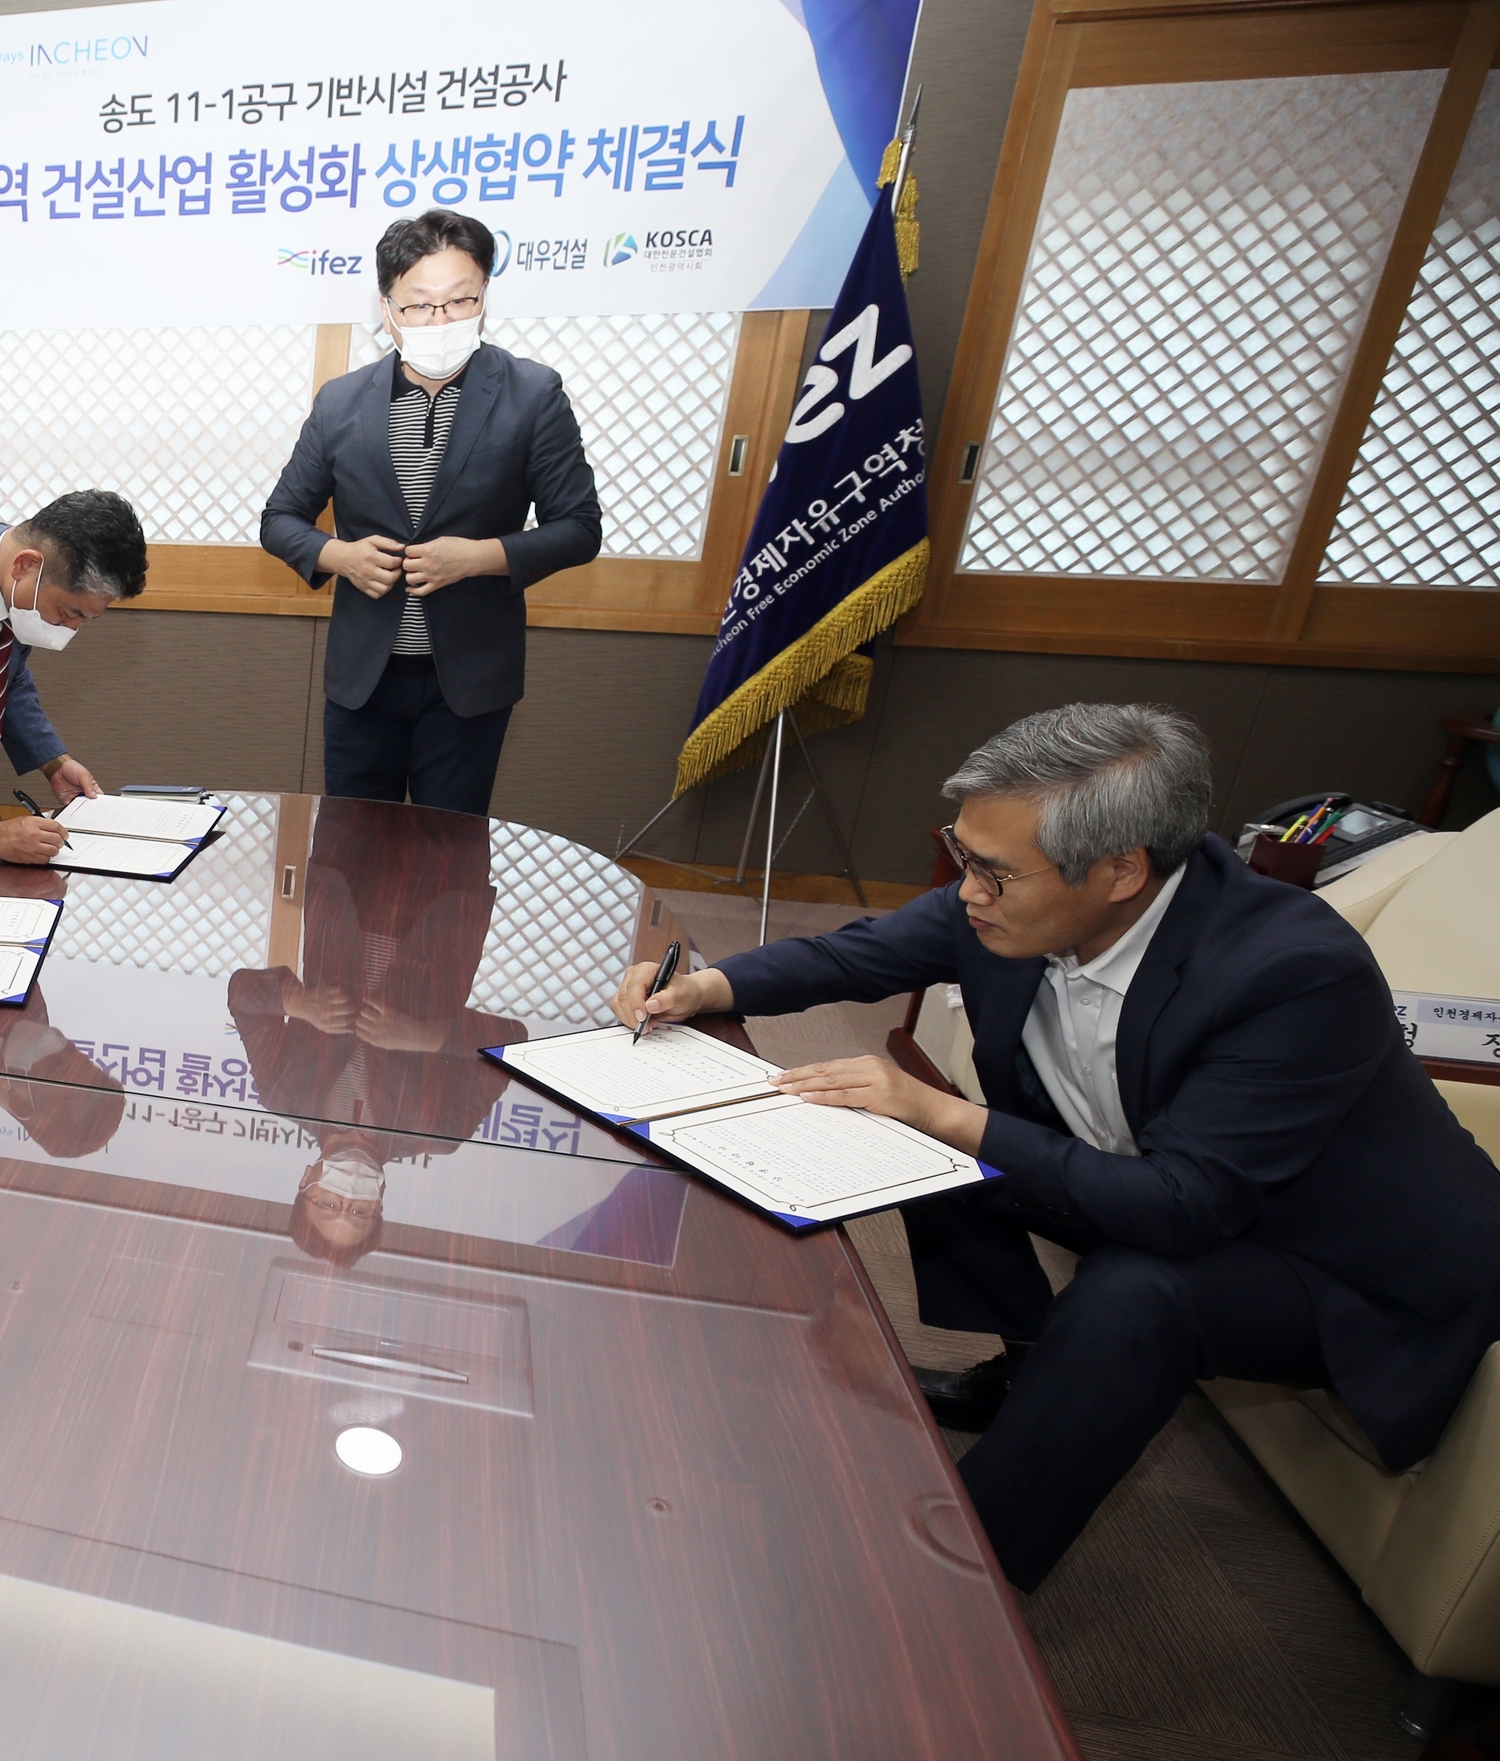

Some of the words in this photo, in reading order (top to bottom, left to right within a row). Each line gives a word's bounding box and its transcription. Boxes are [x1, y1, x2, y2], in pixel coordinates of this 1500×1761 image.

[99, 92, 156, 134] 송도
[167, 81, 298, 125] 11-1공구
[306, 70, 428, 120] 기반시설
[436, 59, 568, 111] 건설공사
[40, 151, 214, 221] 건설산업
[225, 142, 367, 213] 활성화
[374, 131, 575, 209] 상생협약
[582, 114, 746, 192] 체결식
[645, 229, 713, 248] KOSCA
[310, 248, 363, 277] ifez
[516, 237, 588, 272] 대우건설
[643, 248, 713, 260] 대한전문건설협회
[650, 261, 703, 273] 인천광역시회
[746, 590, 775, 622] Free
[774, 542, 841, 597] Economic
[840, 508, 878, 547] Zone
[1433, 1006, 1500, 1024] 인천경제자
